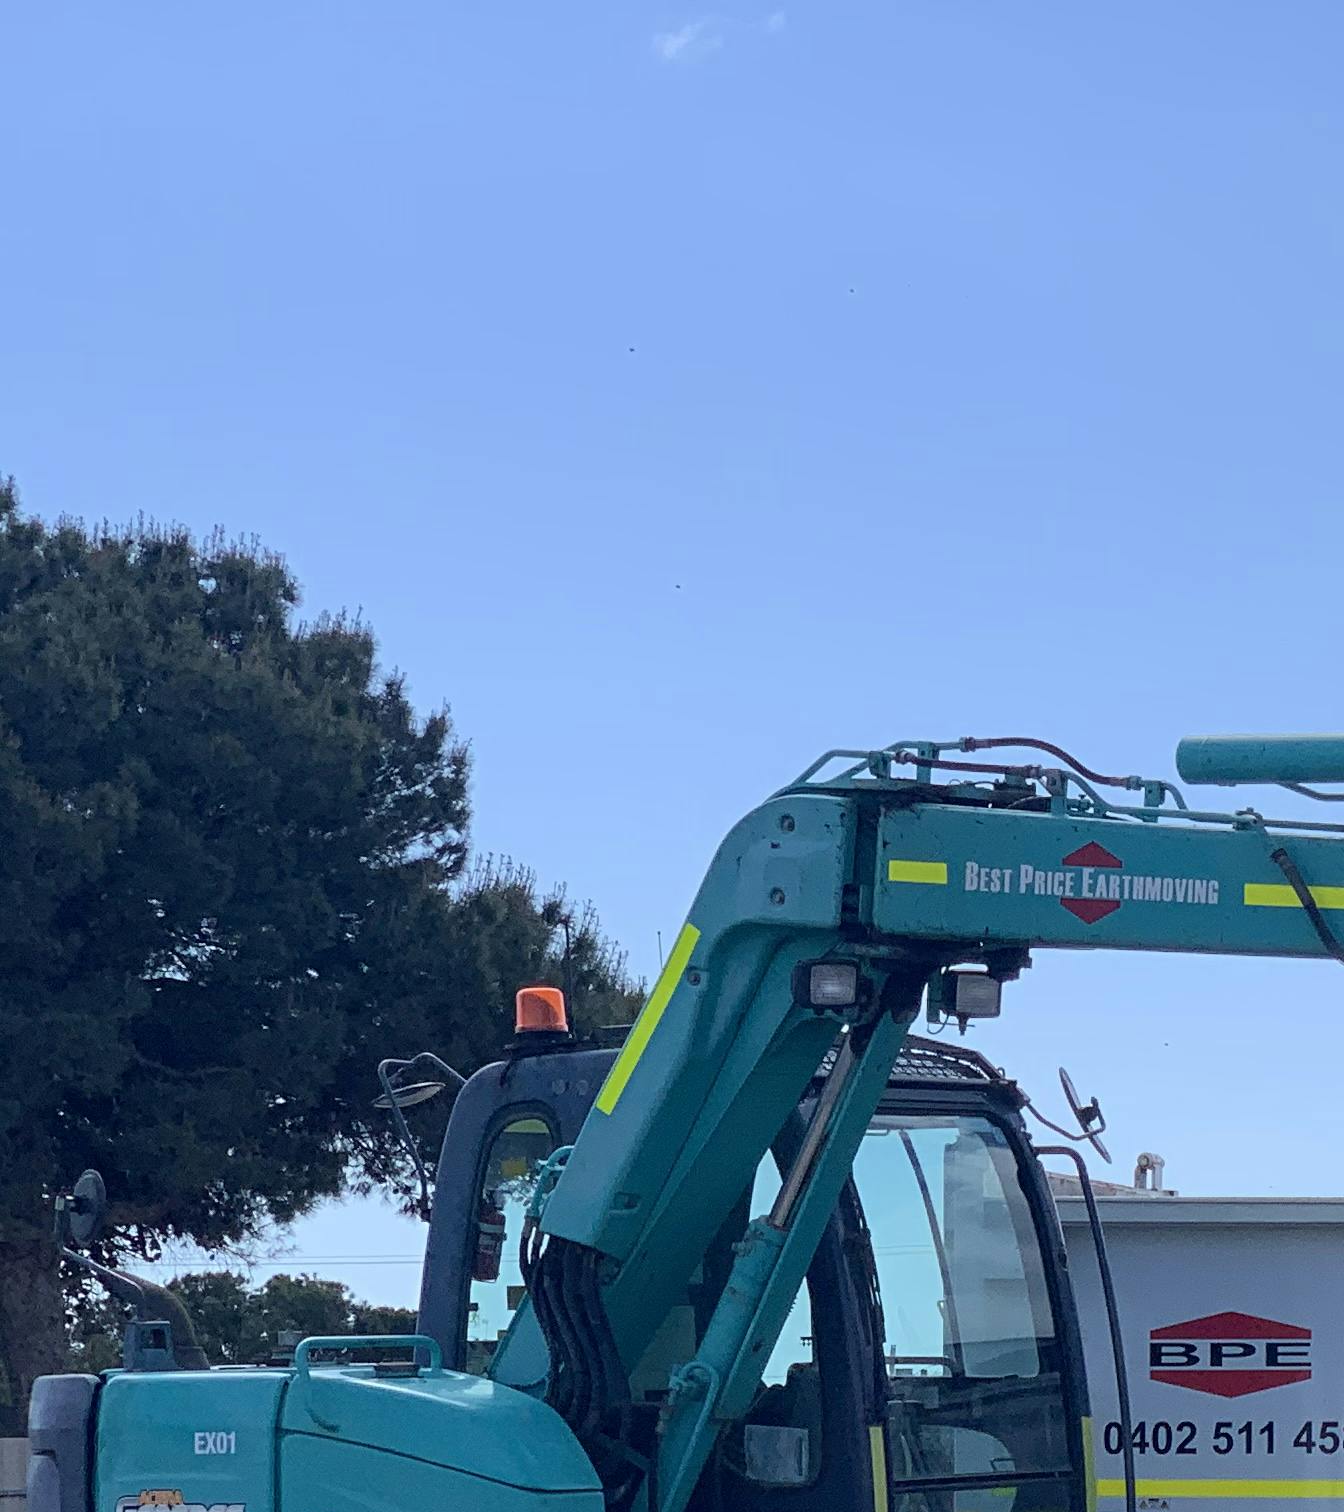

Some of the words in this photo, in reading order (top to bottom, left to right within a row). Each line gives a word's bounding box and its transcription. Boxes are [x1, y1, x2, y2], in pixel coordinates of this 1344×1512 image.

[1149, 1342, 1312, 1367] BPE
[194, 1431, 236, 1455] EX01
[1103, 1421, 1198, 1456] 0402
[1212, 1421, 1276, 1455] 511
